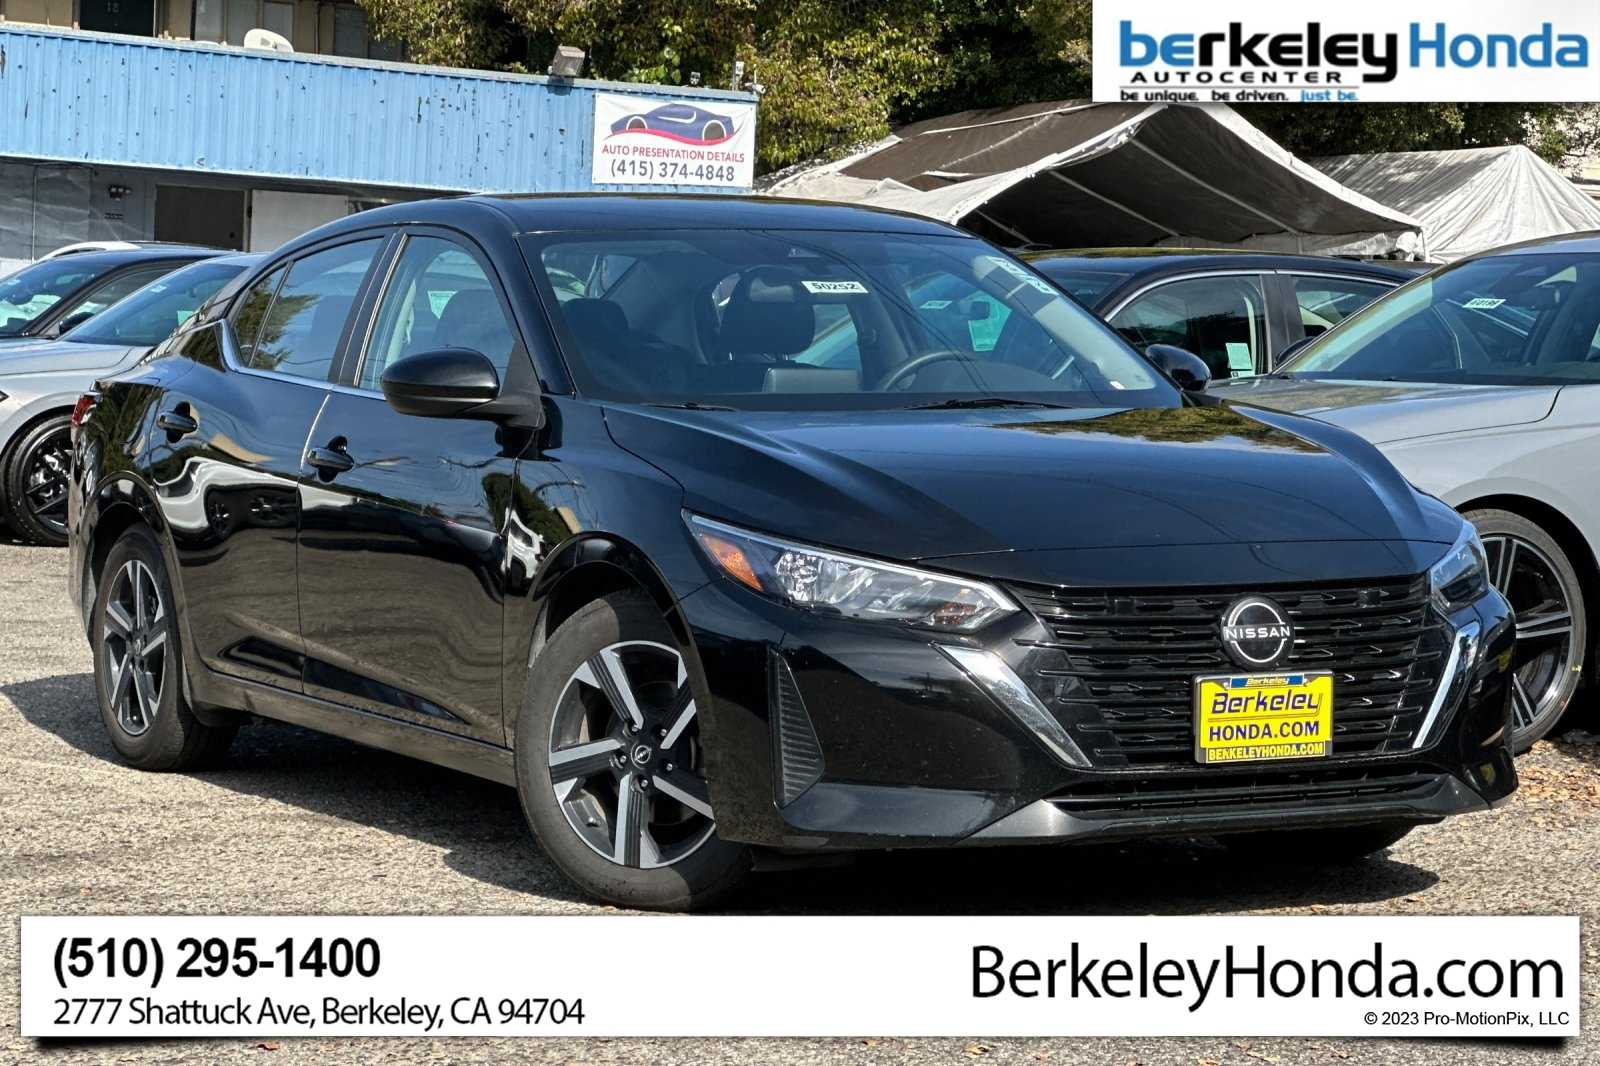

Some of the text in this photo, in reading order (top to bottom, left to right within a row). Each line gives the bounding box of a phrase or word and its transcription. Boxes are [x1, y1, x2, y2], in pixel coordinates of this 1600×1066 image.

[602, 145, 745, 163] AUTO PRESENTATION DETAILS
[611, 158, 735, 182] (415) 374-4848
[1225, 625, 1290, 640] NISSAN
[1247, 676, 1291, 687] Berkeley
[1211, 689, 1323, 716] Berkeley
[1208, 720, 1320, 742] HONDA.COM
[1208, 742, 1324, 761] BERKELEYHONDA.COM
